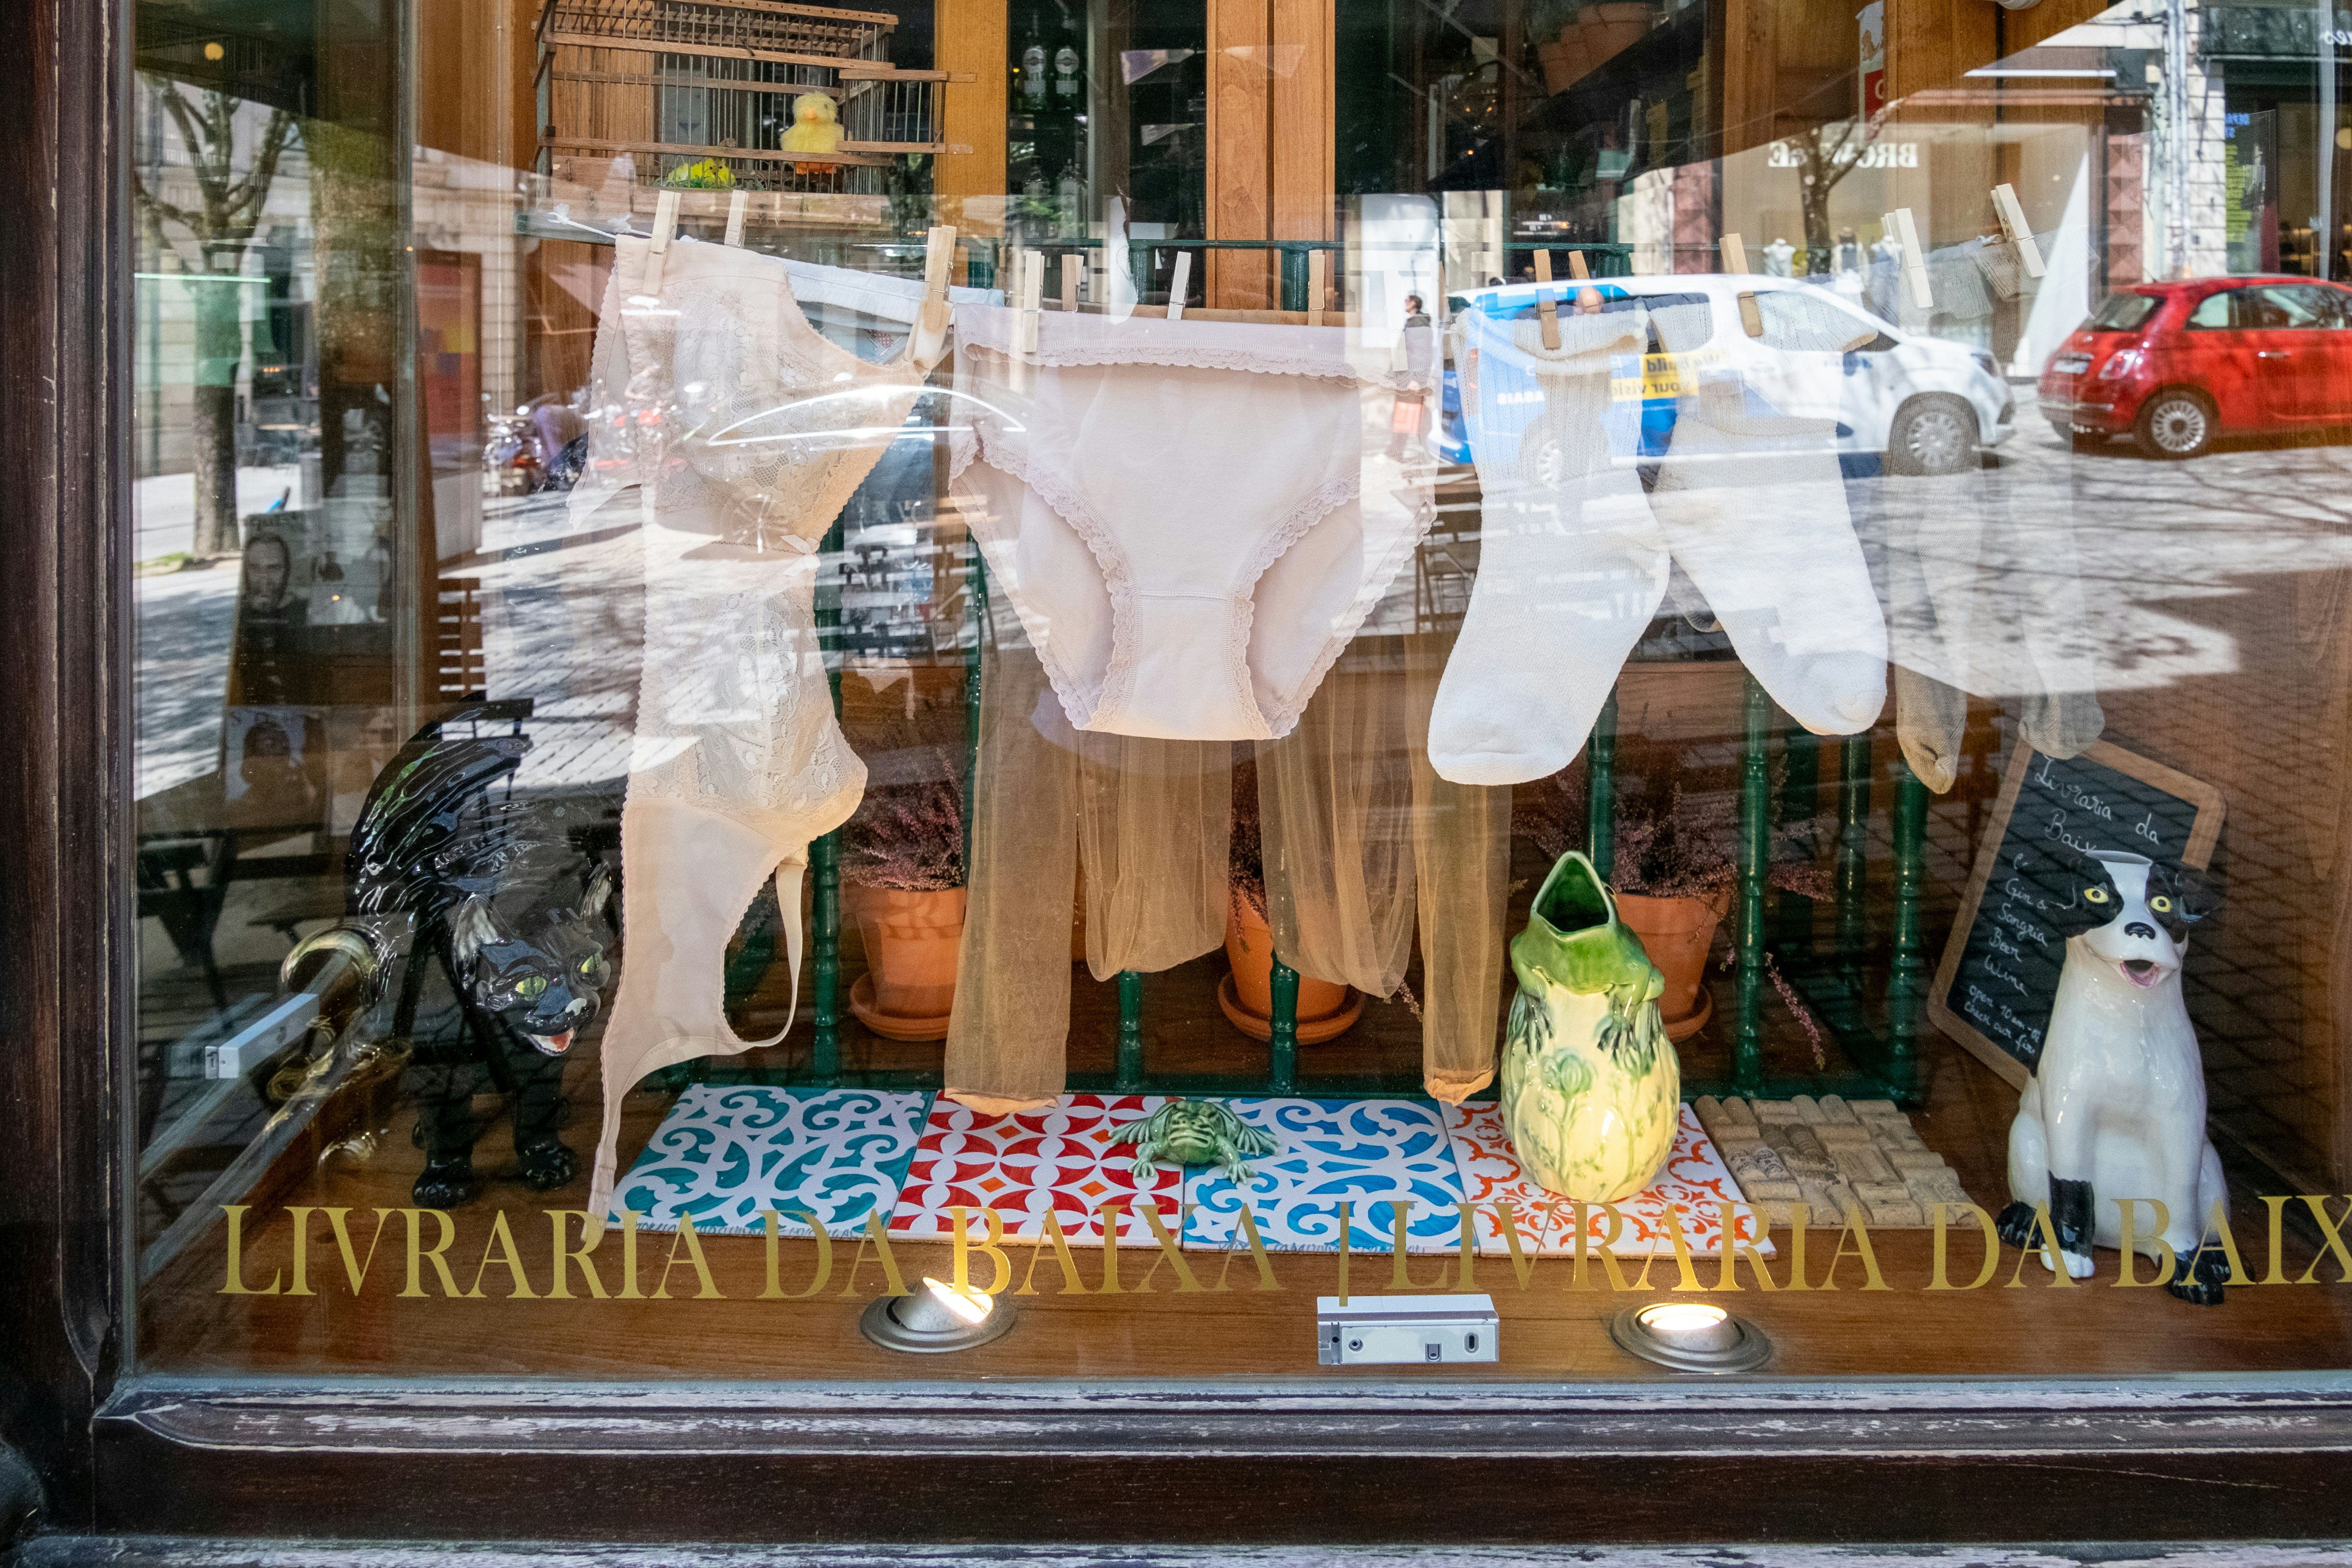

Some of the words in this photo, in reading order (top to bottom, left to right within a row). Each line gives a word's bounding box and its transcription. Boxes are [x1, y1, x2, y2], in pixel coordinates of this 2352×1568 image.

[2034, 754, 2111, 821] Livraria
[2136, 813, 2160, 845] da
[2045, 808, 2096, 853] Baix
[2006, 878, 2033, 905] Gin
[1989, 927, 2022, 963] Beer
[1997, 903, 2048, 947] Sangria
[1984, 955, 2028, 997] Wine
[217, 1205, 727, 1298] LIVRARIA
[756, 1208, 915, 1298] DA
[944, 1202, 1287, 1295] BAIXA
[1383, 1200, 1893, 1291] LIVRARIA
[1923, 1199, 2082, 1290] DA
